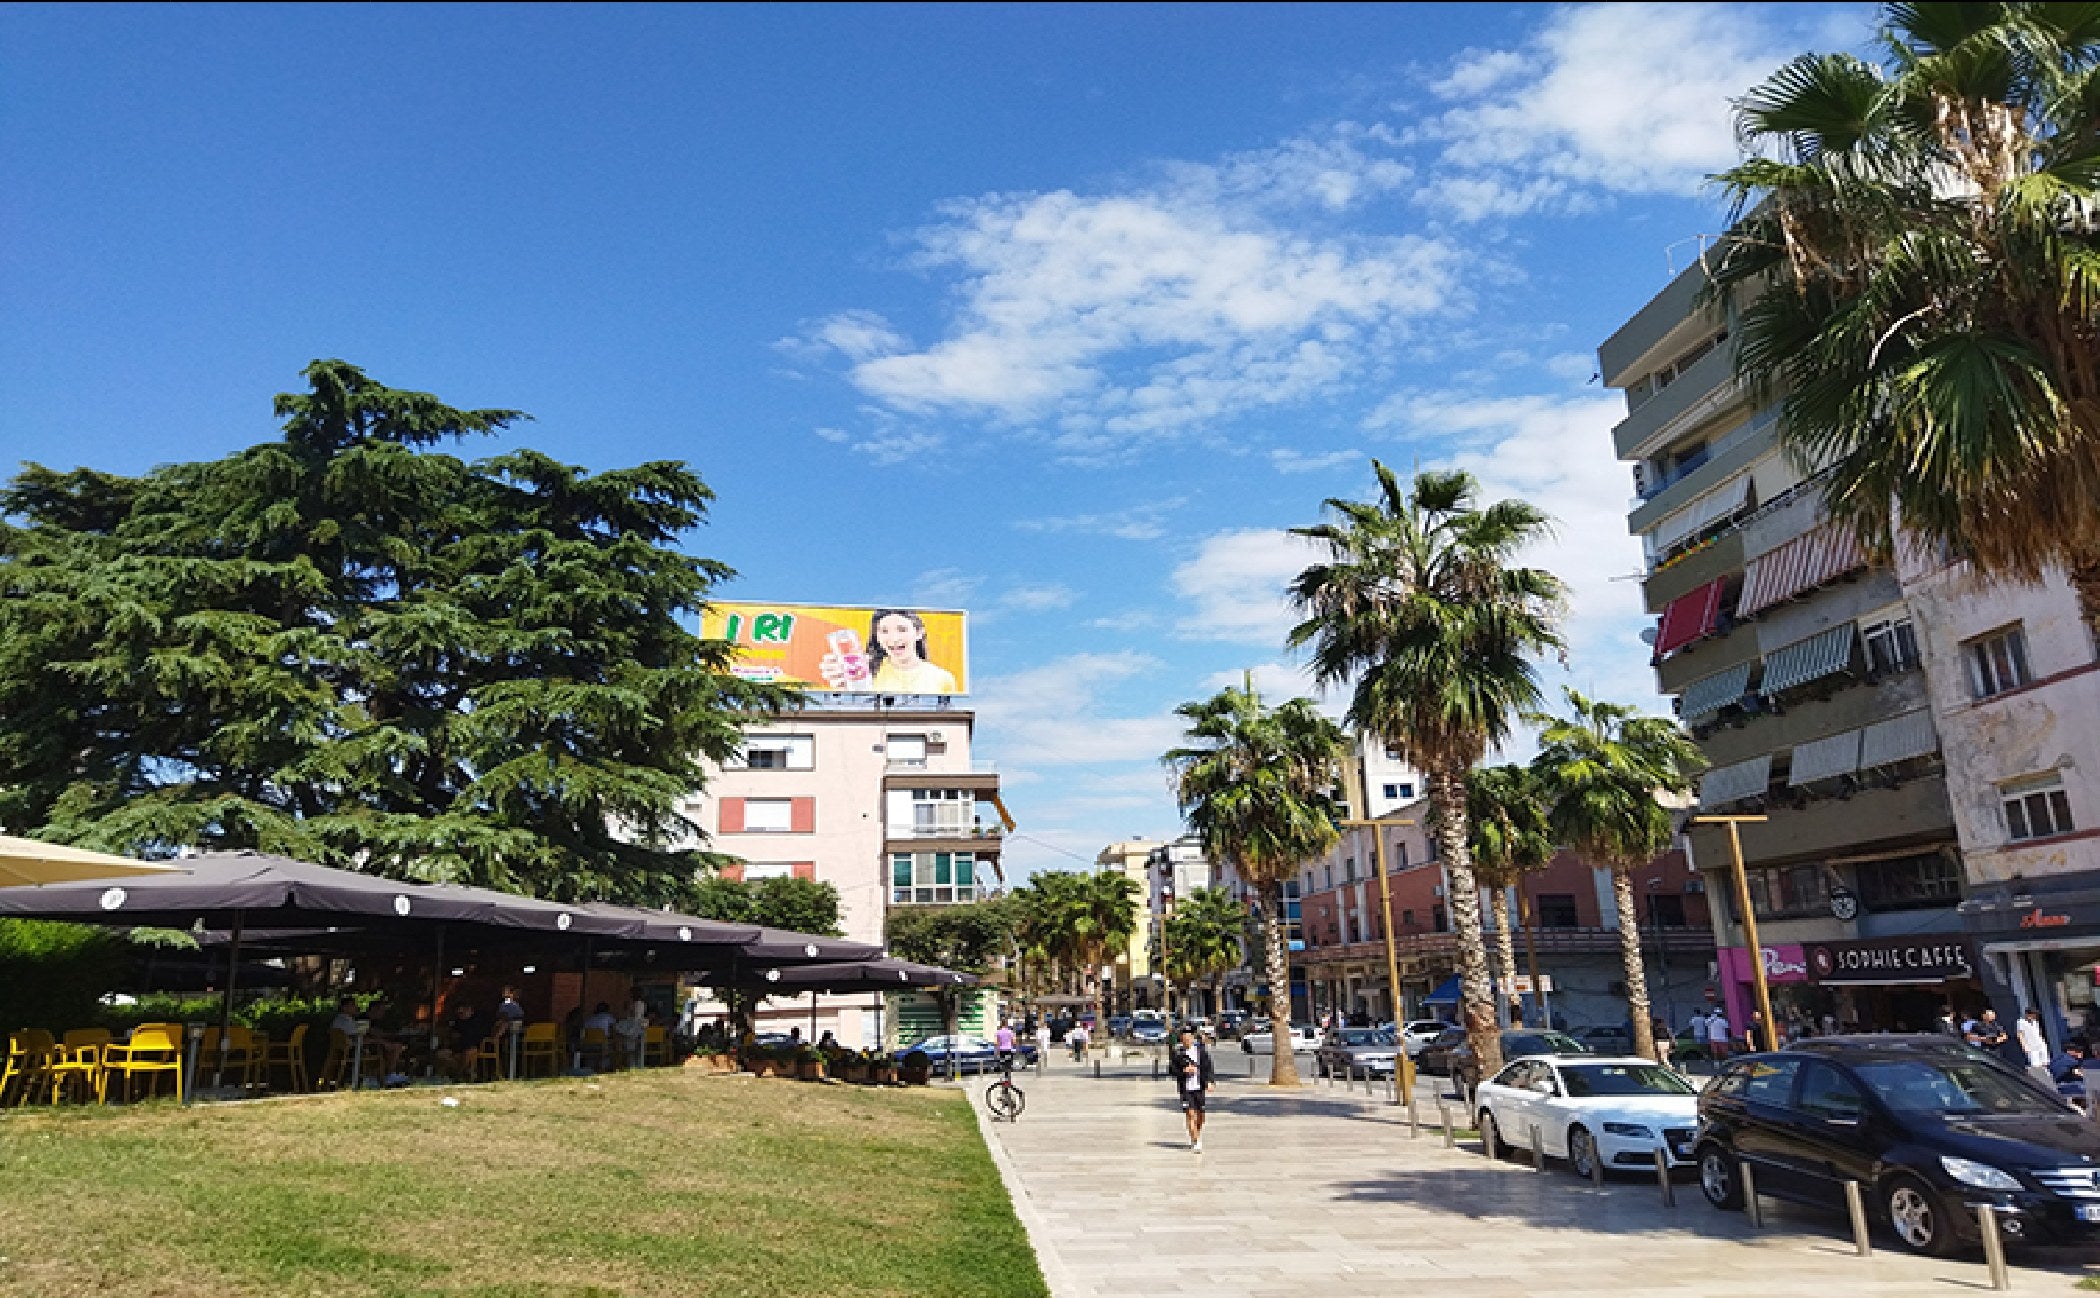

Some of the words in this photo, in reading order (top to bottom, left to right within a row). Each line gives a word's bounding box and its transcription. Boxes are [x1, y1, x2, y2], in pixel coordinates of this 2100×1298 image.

[753, 613, 794, 642] RI
[1838, 949, 1901, 969] SOPHIE
[1905, 945, 1966, 967] CAFFE
